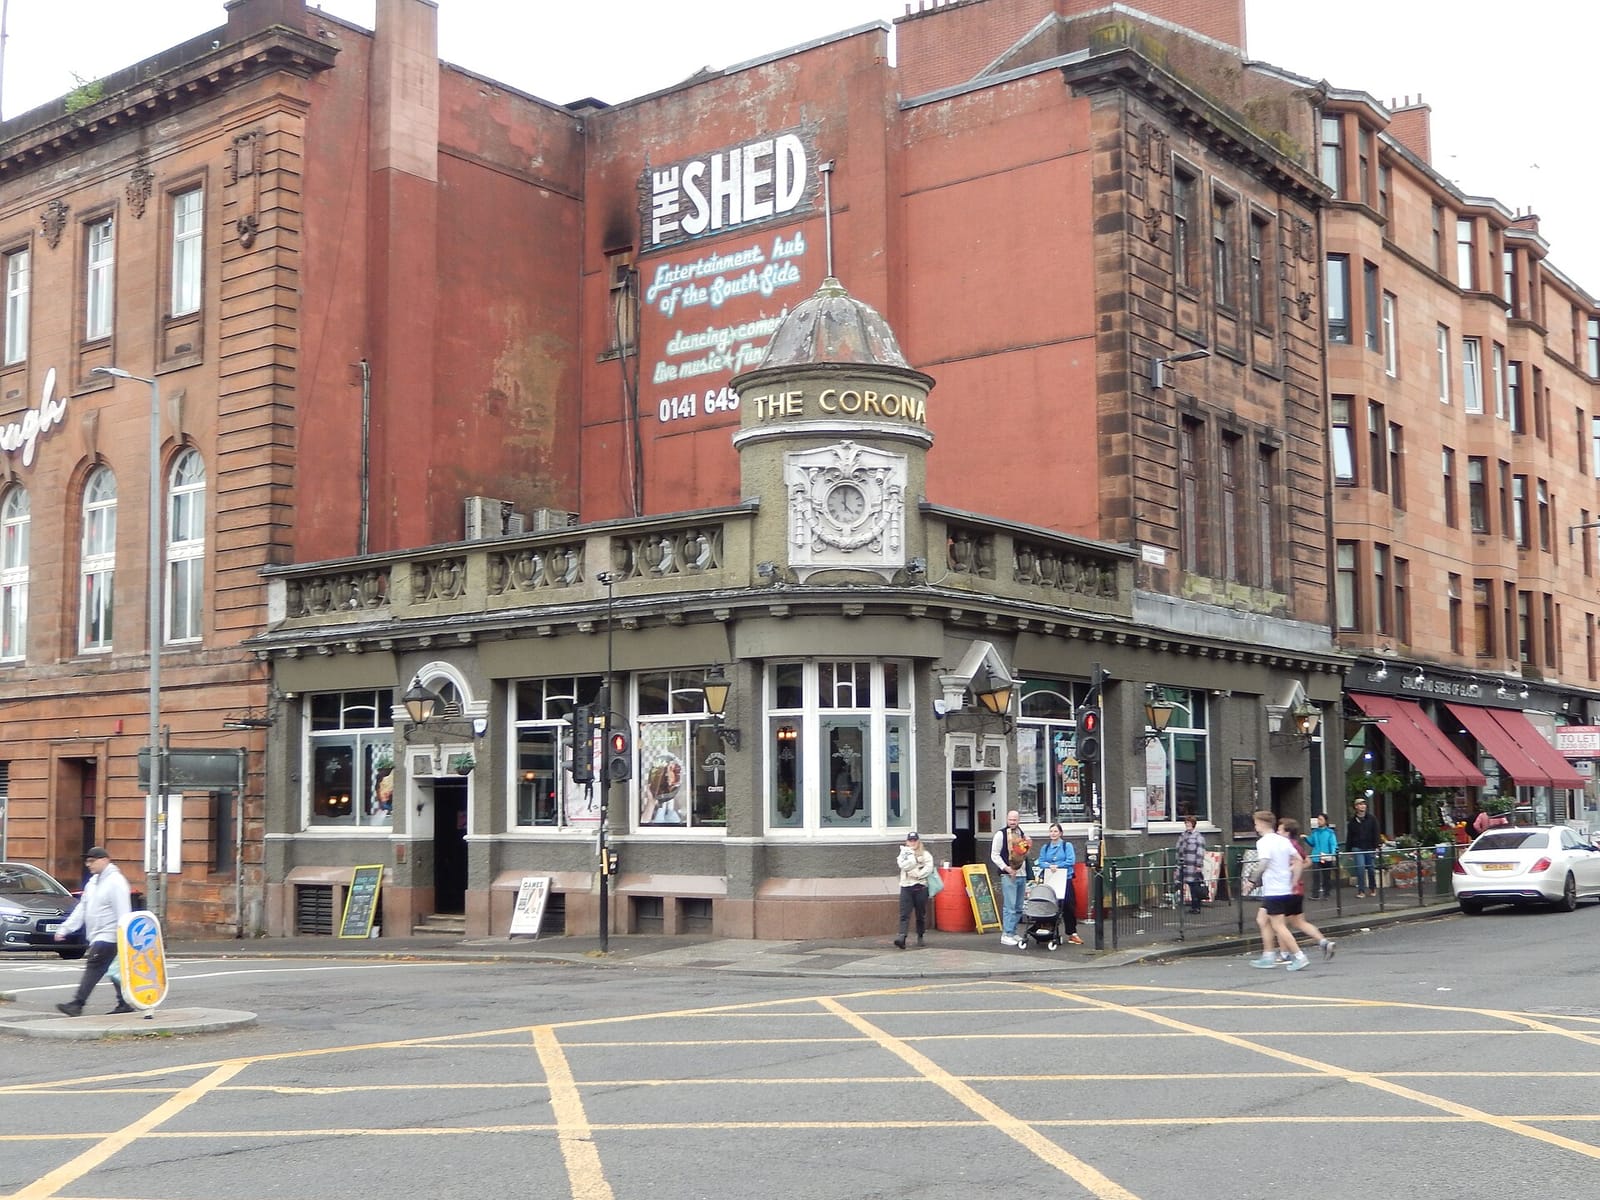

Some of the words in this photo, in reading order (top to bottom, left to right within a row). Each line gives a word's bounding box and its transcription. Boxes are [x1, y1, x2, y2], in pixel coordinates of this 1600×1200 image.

[652, 166, 680, 244] THE
[681, 133, 807, 235] SHED
[646, 244, 765, 302] Entertainment
[771, 231, 805, 260] hub
[660, 287, 681, 317] of
[682, 283, 707, 307] the
[709, 269, 758, 307] South
[759, 260, 801, 296] Side
[666, 326, 729, 355] dancing
[653, 360, 678, 384] live
[679, 351, 722, 378] music
[659, 393, 697, 422] 0141
[753, 389, 804, 420] THE
[818, 388, 927, 423] CORONA
[1560, 734, 1574, 743] TO
[1577, 734, 1597, 743] LET
